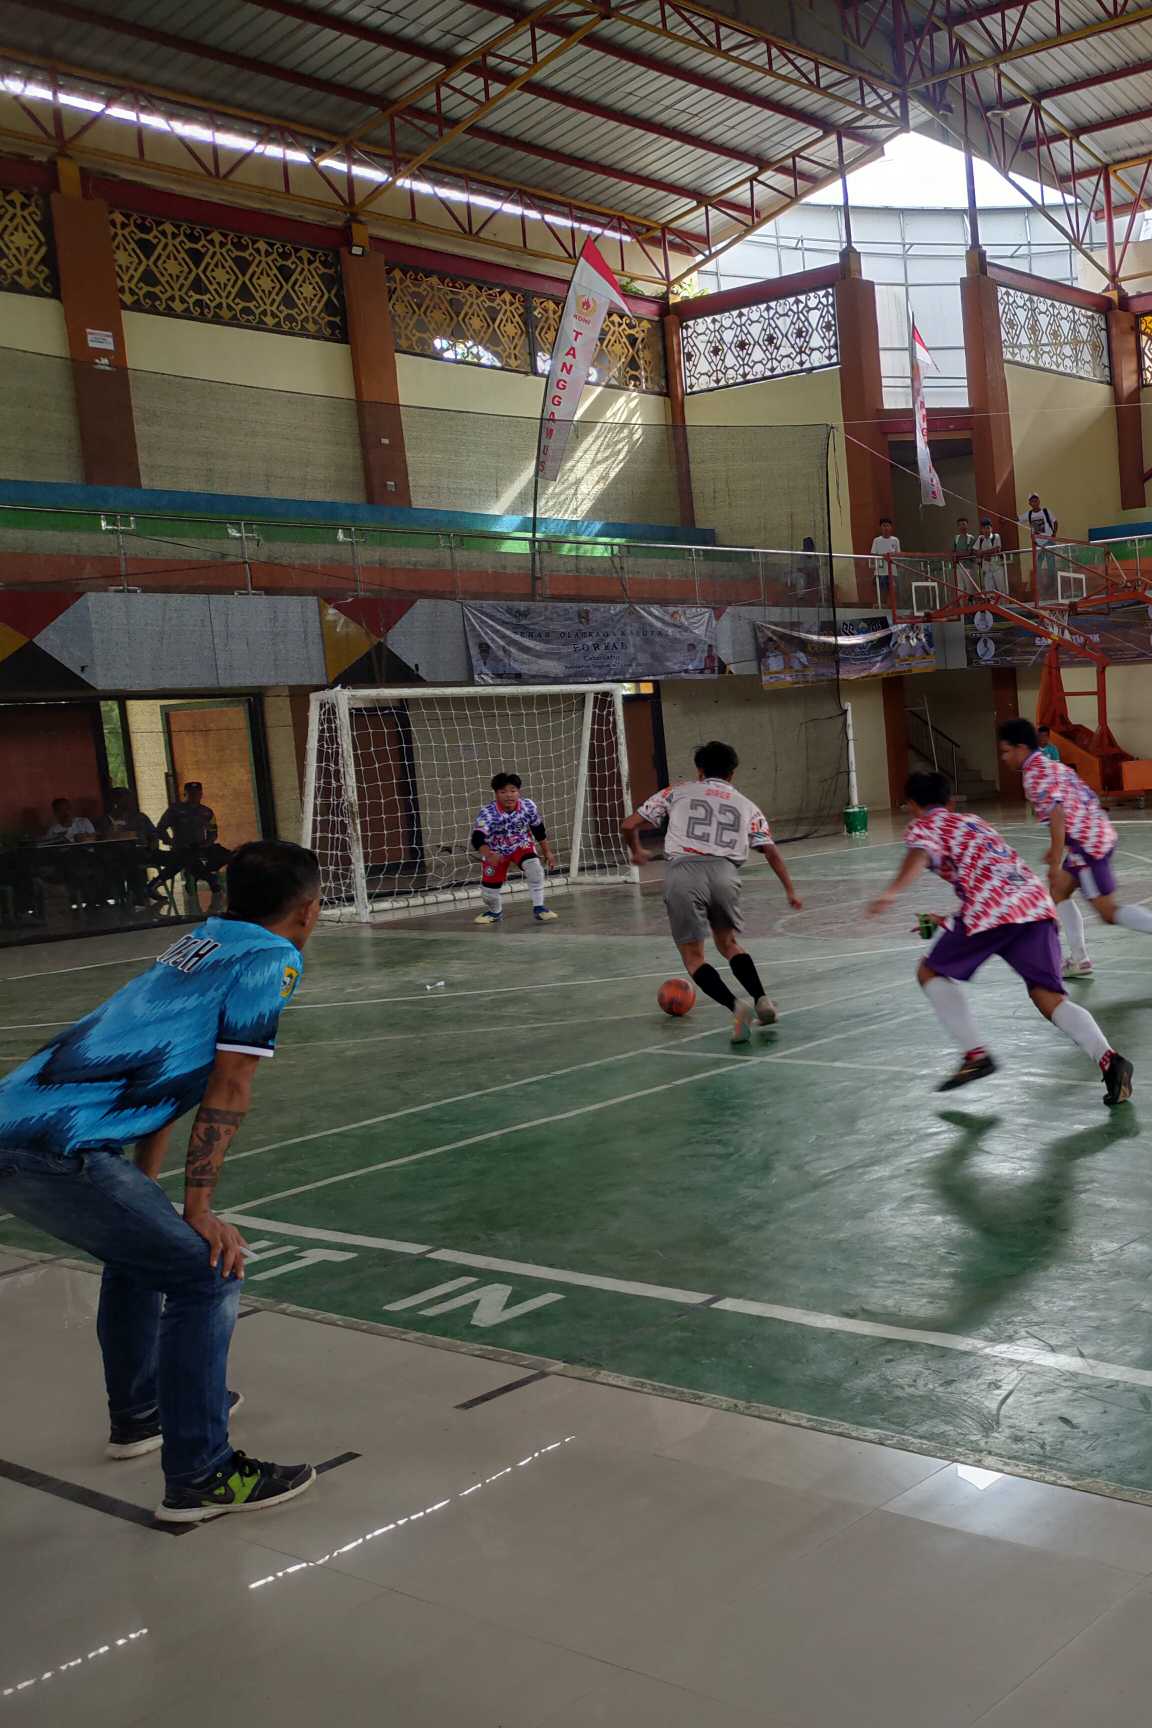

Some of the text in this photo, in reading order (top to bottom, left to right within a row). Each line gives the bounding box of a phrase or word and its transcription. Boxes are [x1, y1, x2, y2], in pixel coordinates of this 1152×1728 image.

[537, 329, 584, 474] TANGGAMUS
[686, 798, 742, 850] 22
[382, 1275, 567, 1328] IN
